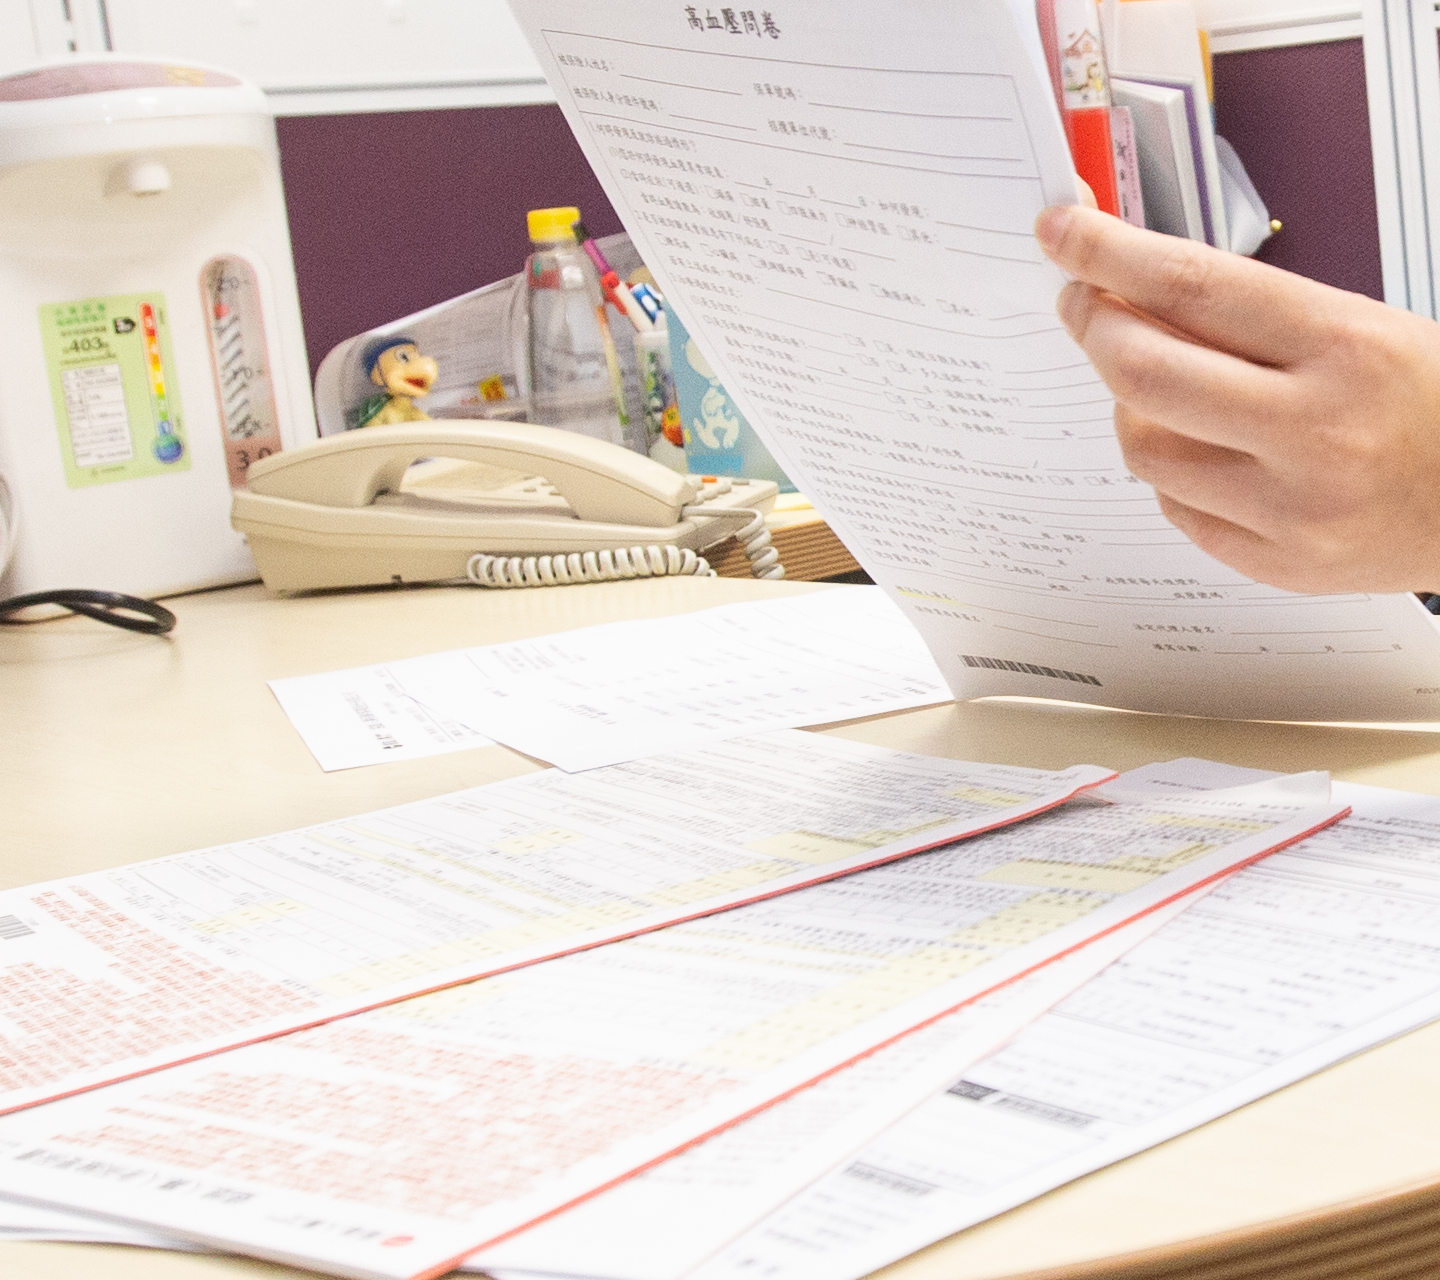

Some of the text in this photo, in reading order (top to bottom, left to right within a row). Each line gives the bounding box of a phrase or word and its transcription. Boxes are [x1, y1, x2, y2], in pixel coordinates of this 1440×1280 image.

[685, 4, 782, 40] 高血壓問卷
